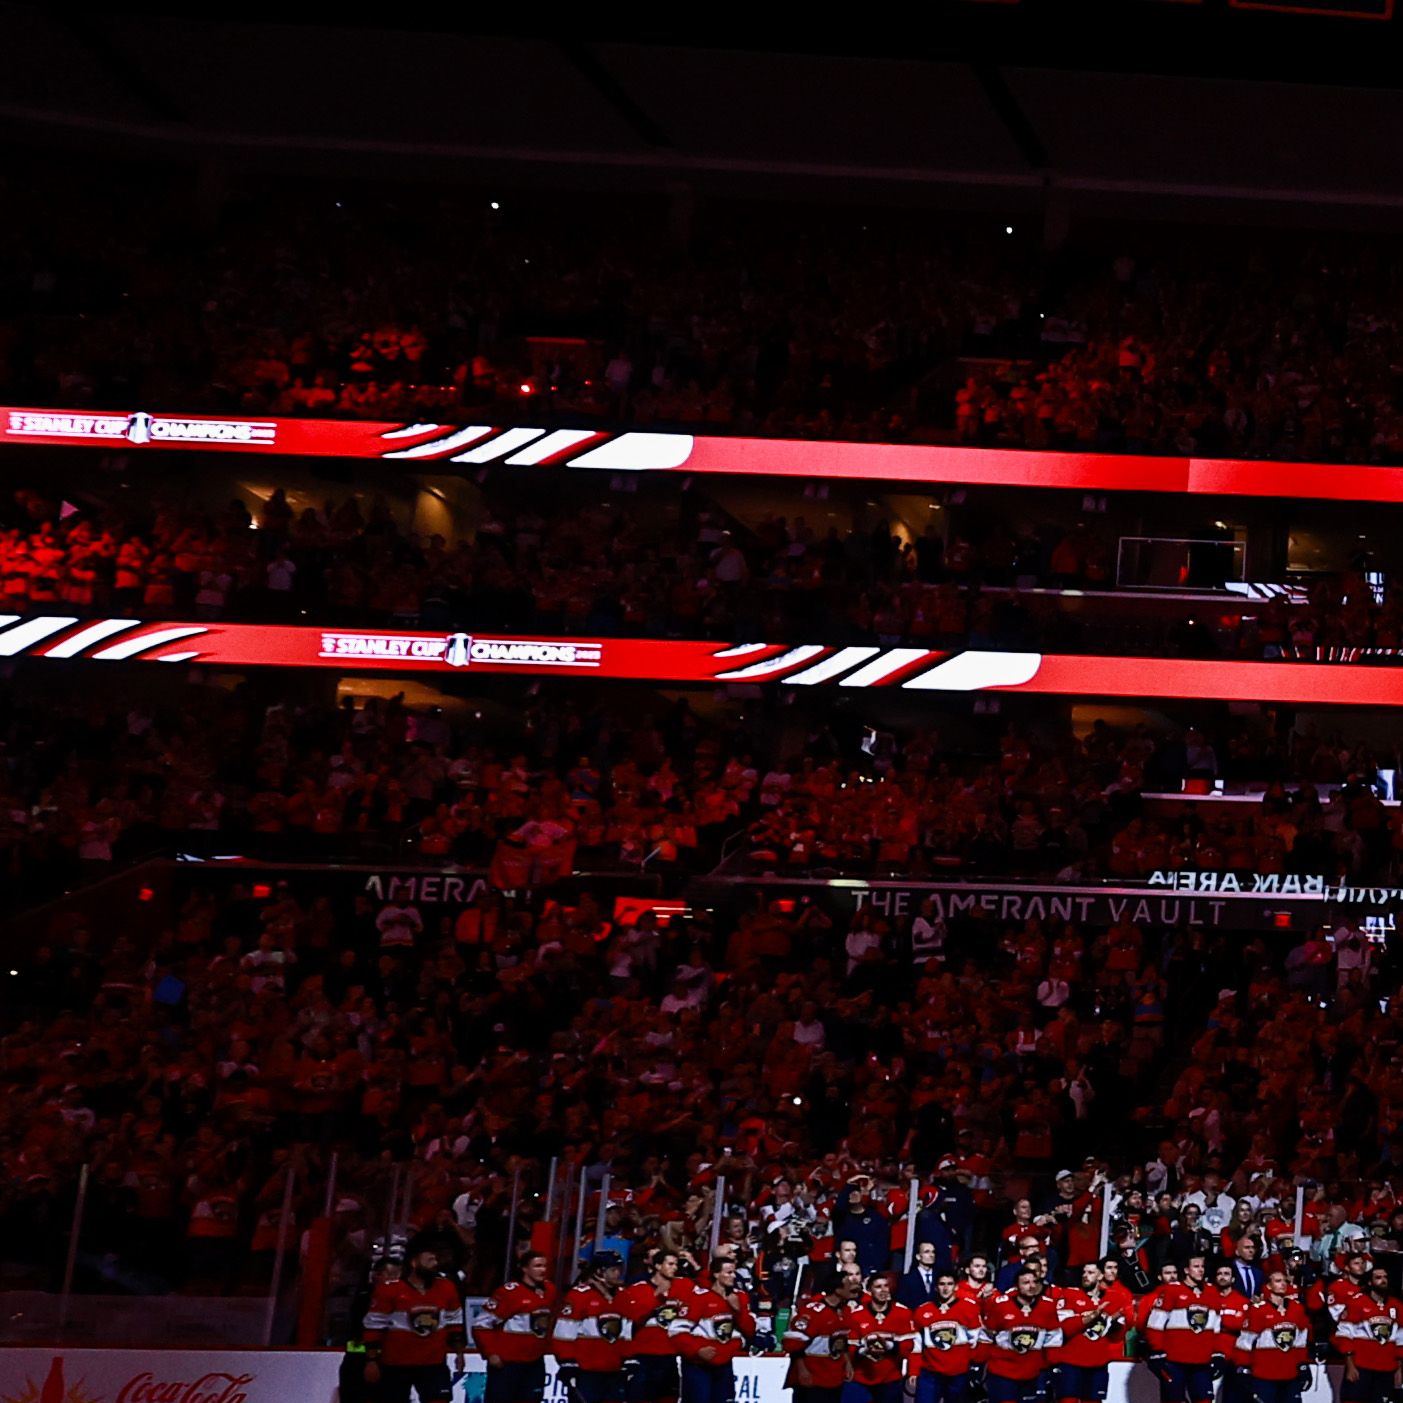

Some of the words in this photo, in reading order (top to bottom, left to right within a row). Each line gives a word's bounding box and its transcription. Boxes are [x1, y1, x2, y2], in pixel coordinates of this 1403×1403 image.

[471, 642, 576, 662] CHAMPIONS
[364, 875, 534, 903] AMERA
[1108, 897, 1227, 926] VAULT
